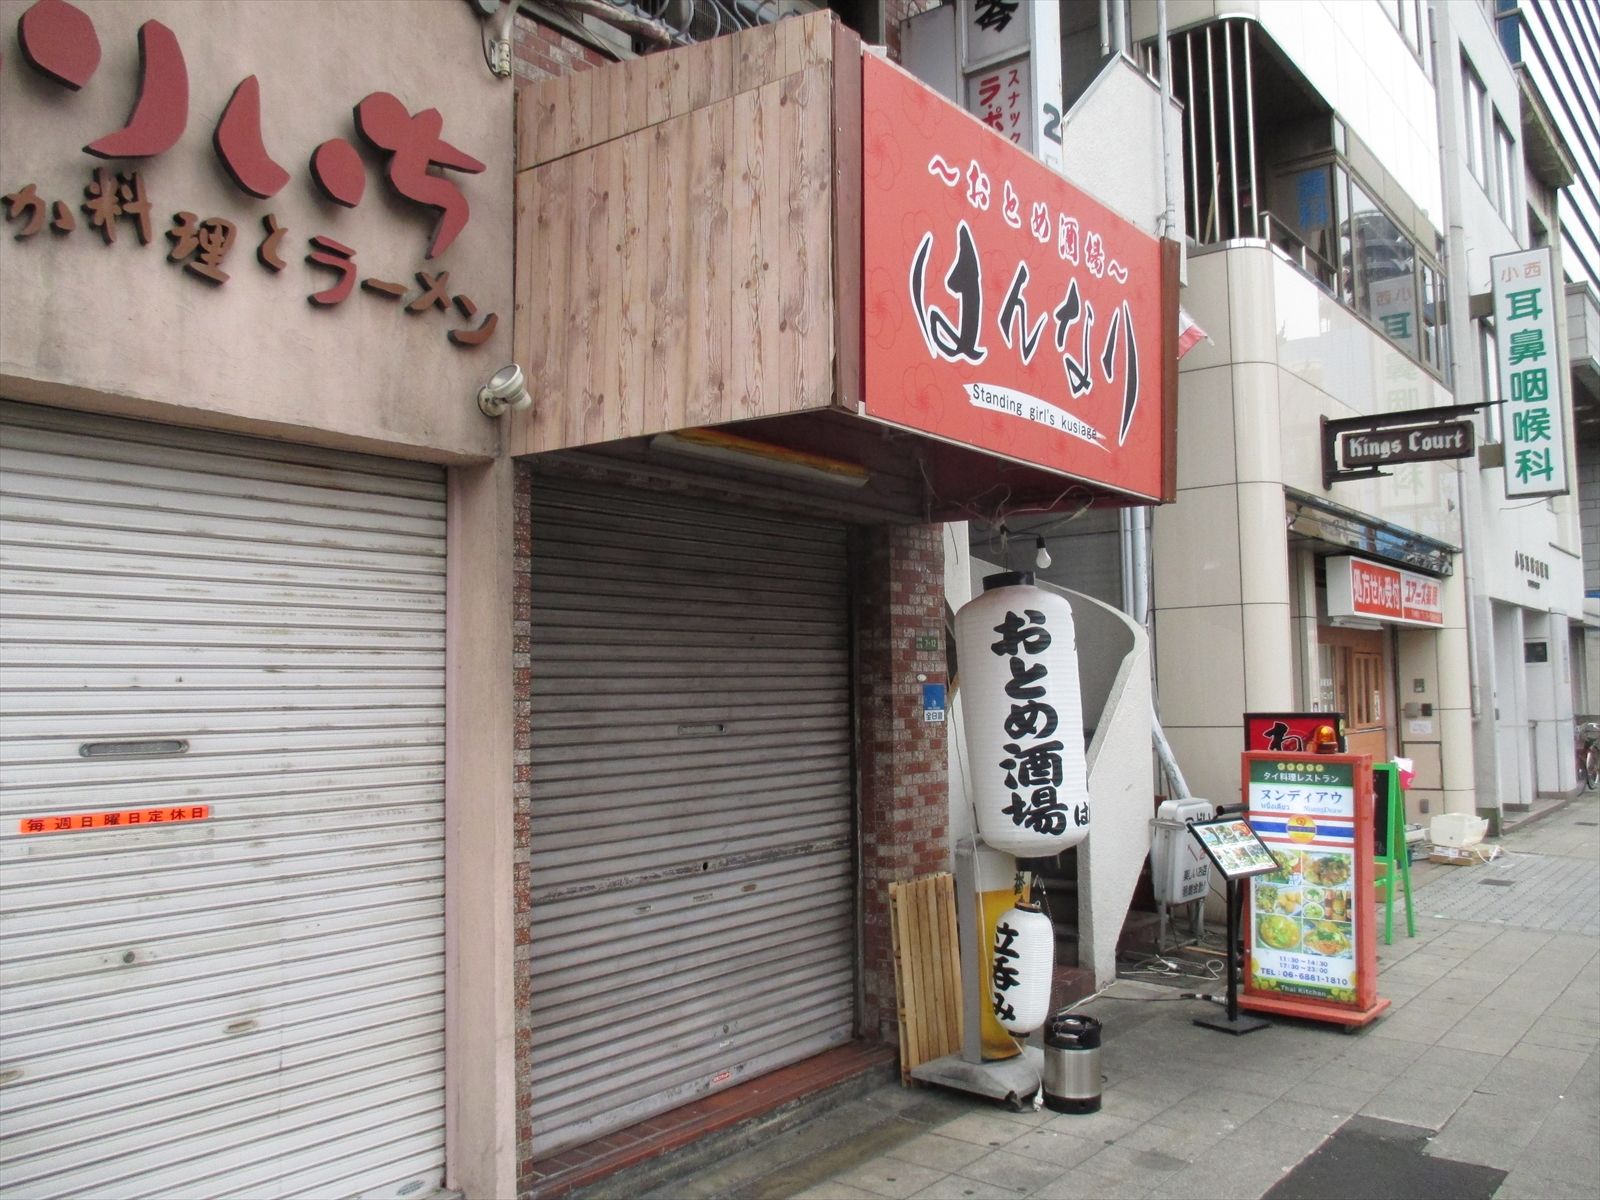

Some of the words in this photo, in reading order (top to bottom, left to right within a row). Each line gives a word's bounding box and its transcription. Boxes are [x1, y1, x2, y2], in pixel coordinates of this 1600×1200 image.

[1008, 69, 1021, 144] スナック
[1501, 261, 1542, 283] 小西
[909, 219, 1139, 447] はんなり
[1505, 287, 1554, 484] 耳鼻咽喉科
[972, 383, 1023, 416] Standing
[1029, 406, 1055, 426] girl's
[1061, 415, 1098, 440] kusiage
[1350, 436, 1402, 459] Kings
[1408, 429, 1464, 452] Court
[991, 609, 1068, 836] おとめ酒場
[1261, 789, 1343, 804] ヌンディアウ
[1263, 771, 1339, 783] タイ料理レストラン
[27, 807, 204, 832] 毎週日曜日定休日
